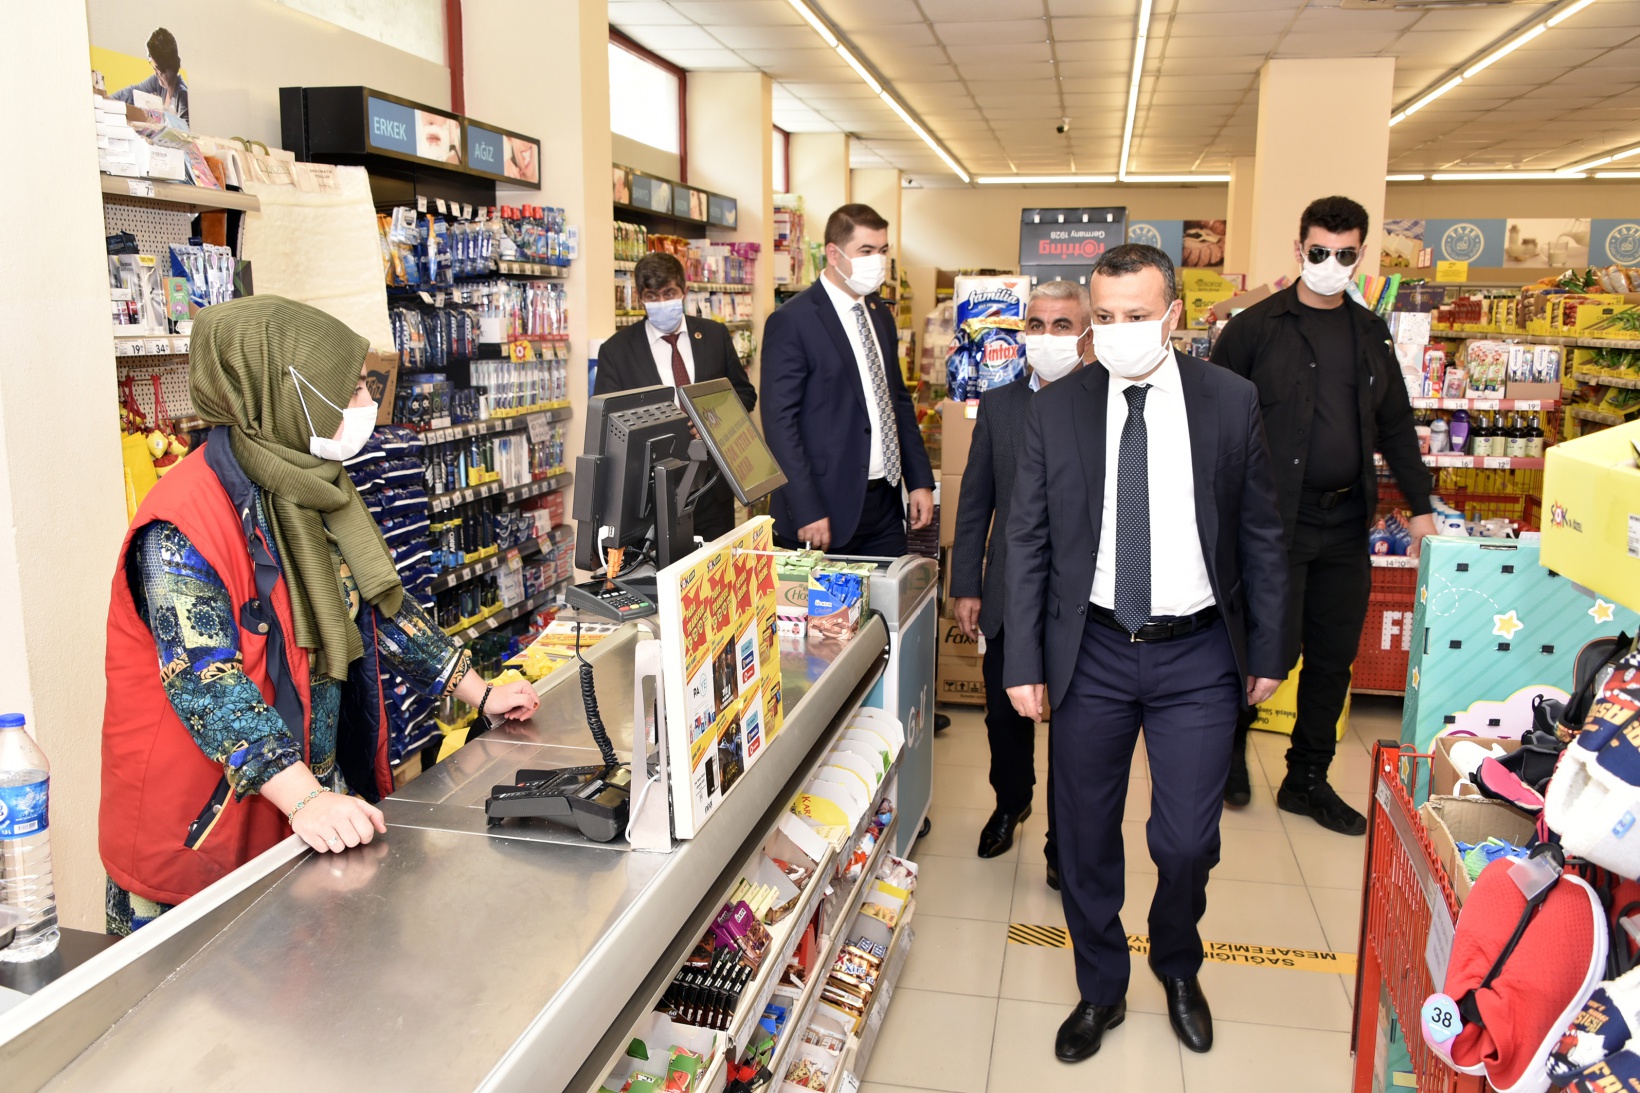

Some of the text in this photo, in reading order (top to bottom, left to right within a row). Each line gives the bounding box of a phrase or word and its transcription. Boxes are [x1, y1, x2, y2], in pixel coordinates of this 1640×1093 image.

[373, 116, 407, 141] ERKEK
[474, 142, 494, 162] AĞIZ
[1050, 230, 1105, 239] Germany 1928
[1449, 225, 1478, 238] TAZE
[1039, 239, 1105, 259] rotring
[968, 287, 1018, 309] familia
[132, 345, 140, 353] 19
[156, 344, 165, 353] 34
[1375, 543, 1387, 552] Pril
[1210, 942, 1337, 961] MESAFEMİZİ
[844, 963, 867, 976] Xiro
[1431, 1007, 1453, 1028] 38
